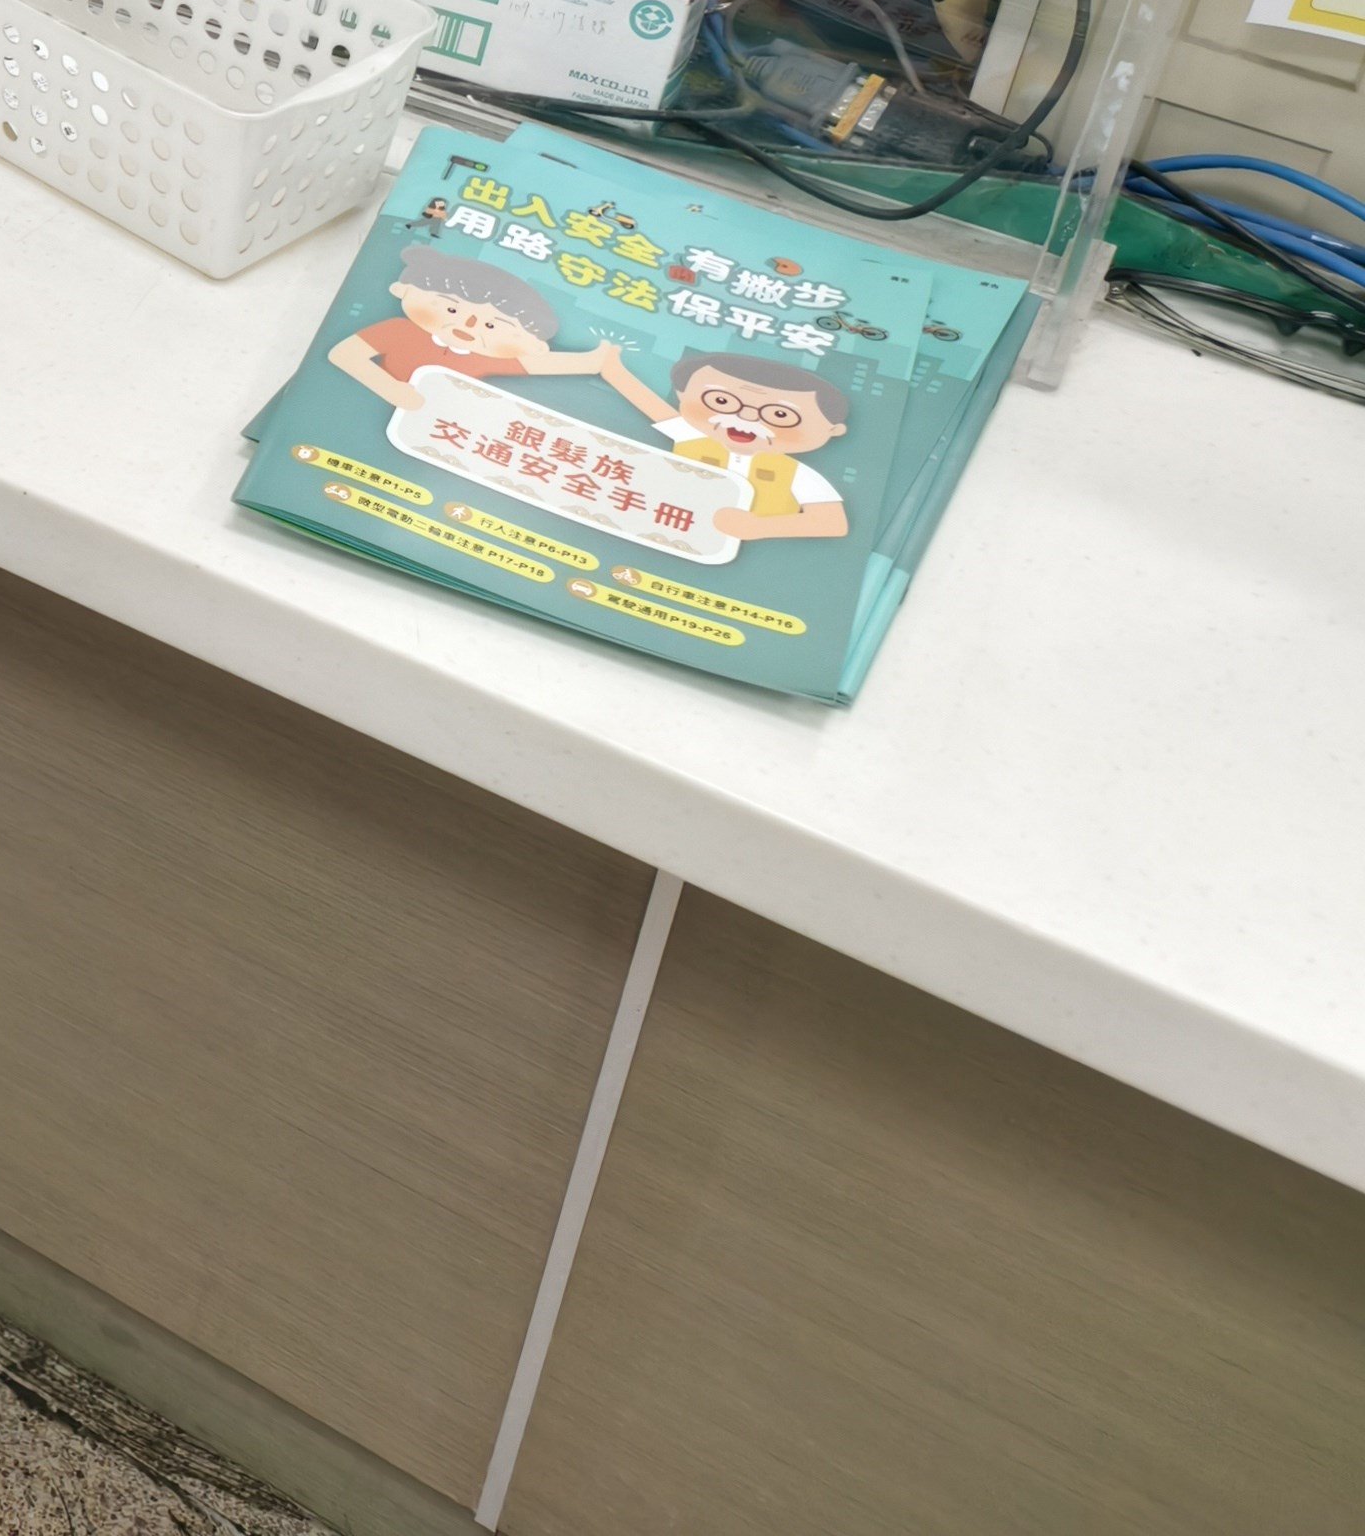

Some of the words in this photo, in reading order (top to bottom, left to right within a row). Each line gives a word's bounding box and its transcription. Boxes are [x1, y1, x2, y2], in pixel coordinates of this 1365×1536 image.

[568, 69, 599, 85] MAX
[593, 89, 614, 100] MADE
[462, 177, 664, 268] 出入安全
[685, 246, 846, 309] 有撇步
[505, 419, 636, 486] 銀髮族
[429, 417, 696, 533] 交通安全手冊
[488, 549, 545, 579] P17-P18
[730, 604, 794, 631] P14-P16
